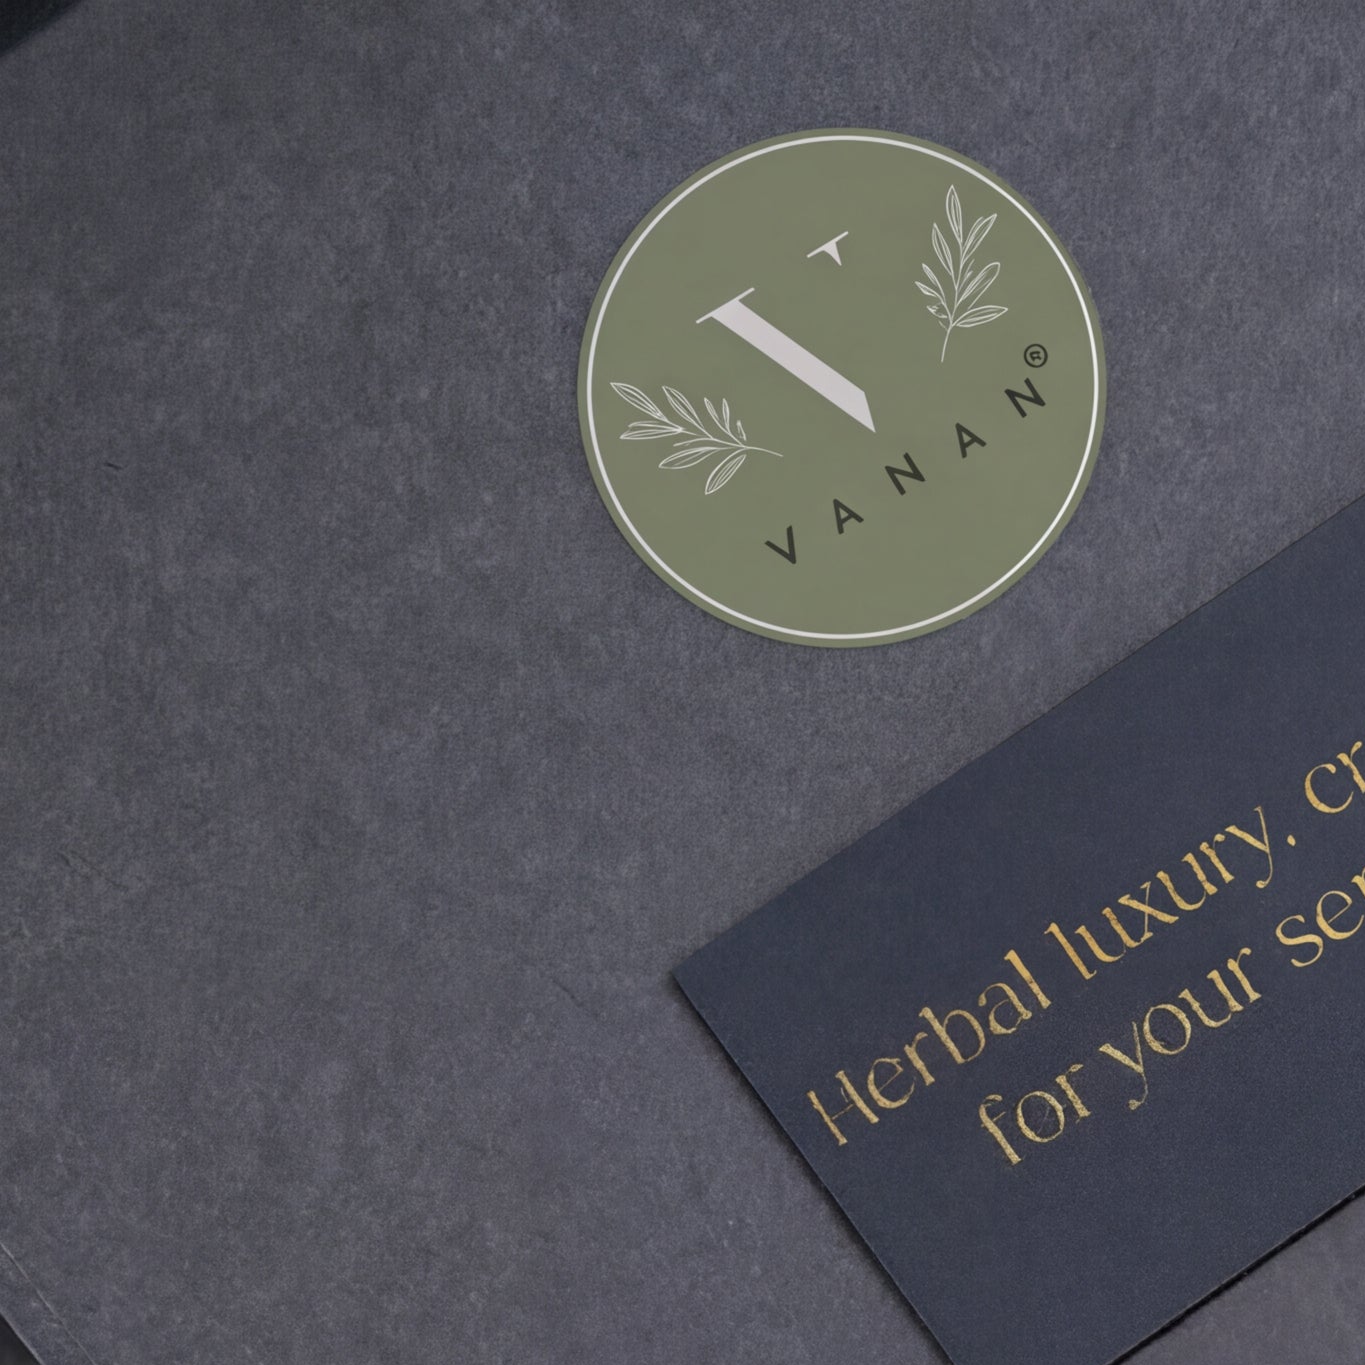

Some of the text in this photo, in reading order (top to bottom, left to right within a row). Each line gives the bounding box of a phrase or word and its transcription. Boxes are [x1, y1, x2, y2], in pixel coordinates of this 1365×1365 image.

[805, 950, 1051, 1147] Herbal
[979, 1059, 1092, 1167] for
[1098, 945, 1264, 1111] your
